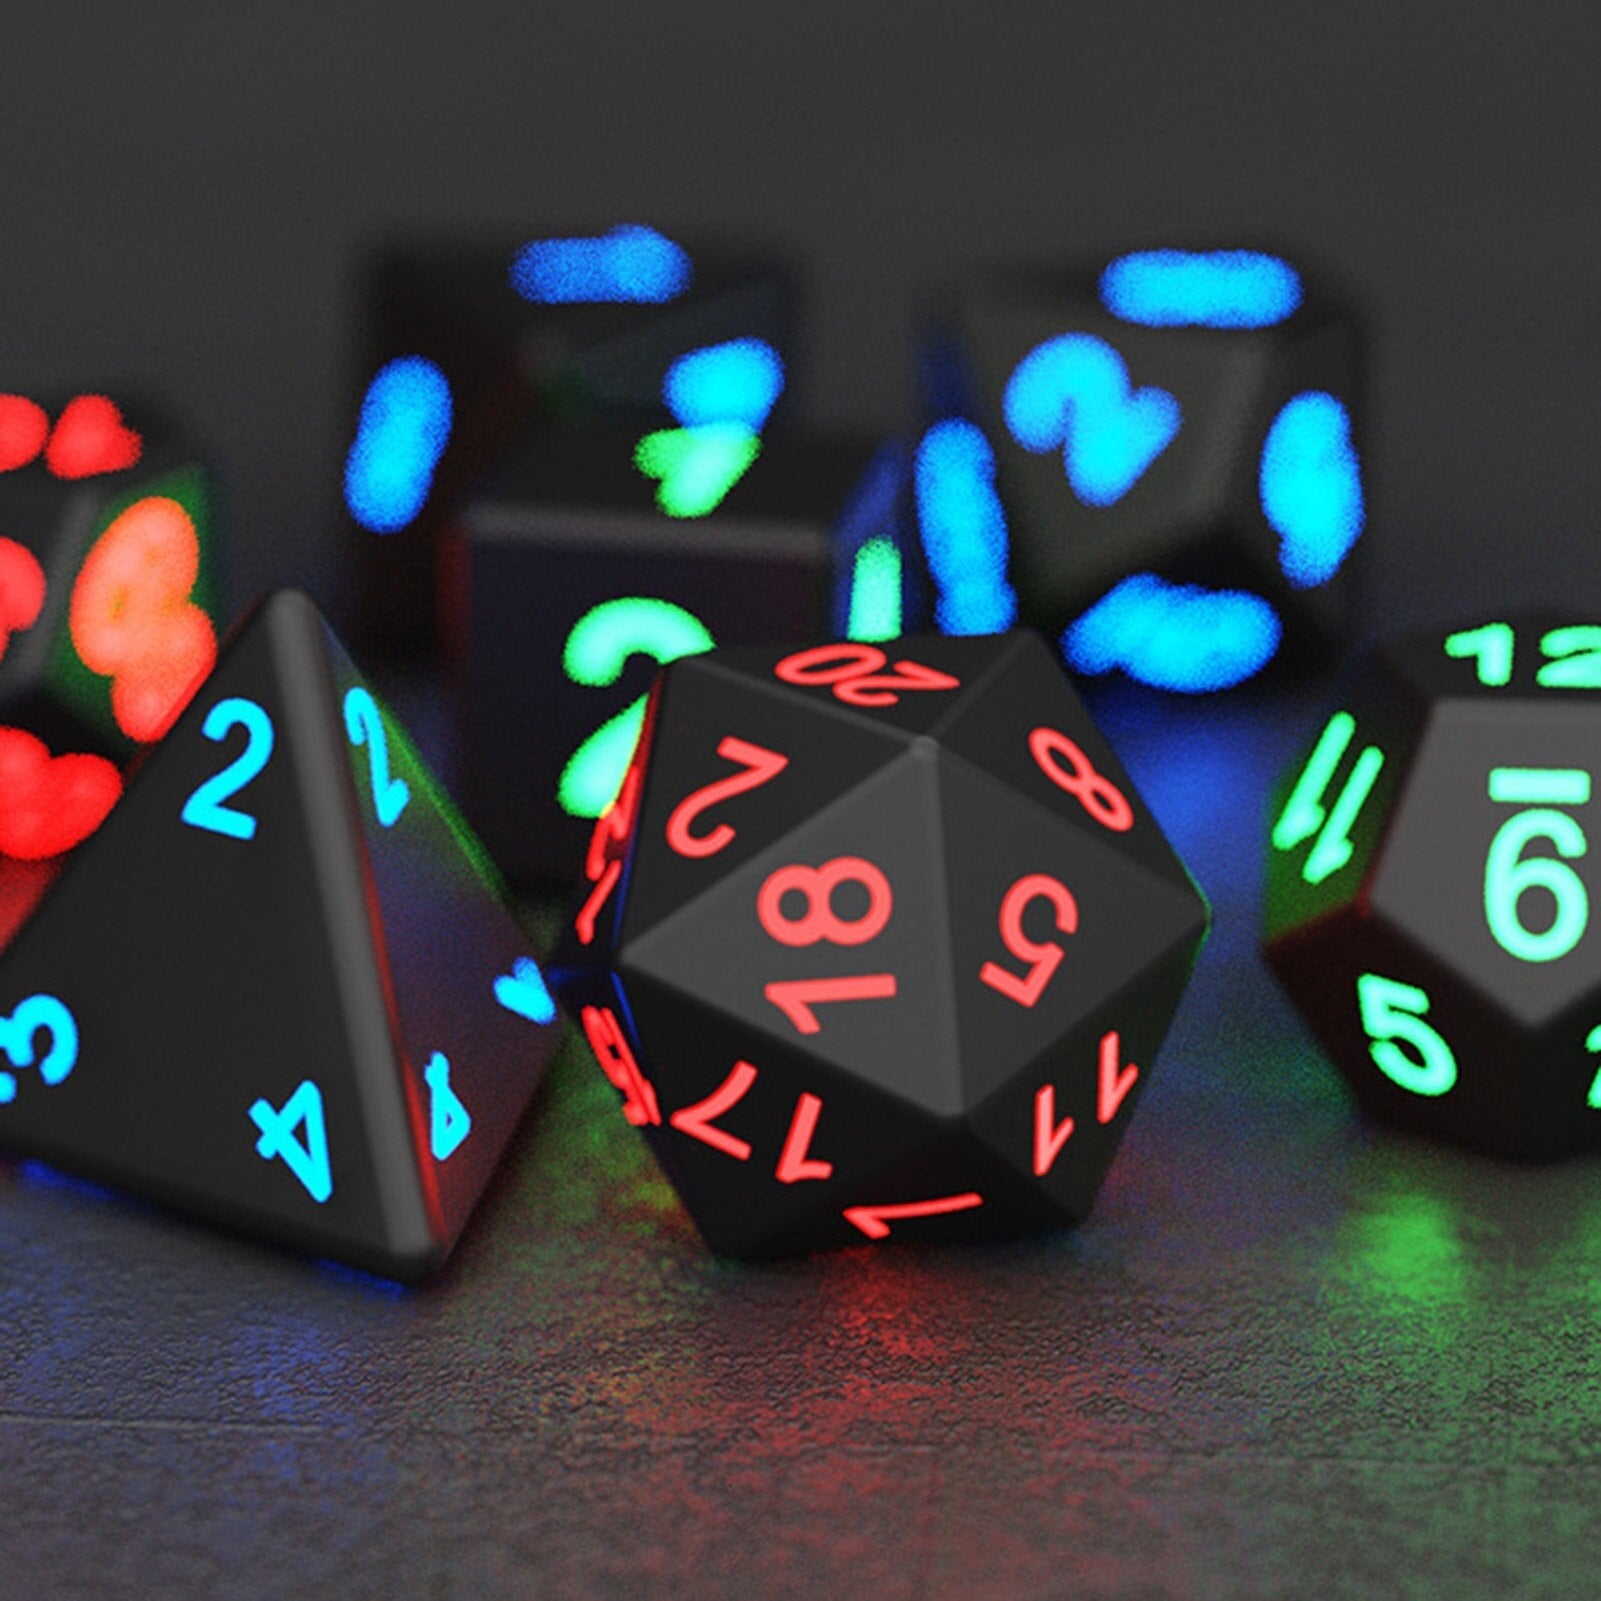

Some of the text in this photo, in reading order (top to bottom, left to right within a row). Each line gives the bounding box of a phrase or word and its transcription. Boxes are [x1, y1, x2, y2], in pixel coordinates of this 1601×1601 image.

[776, 644, 960, 706] 20
[182, 698, 273, 839] 2
[344, 687, 410, 827] 2
[666, 736, 788, 858] 2
[1029, 727, 1134, 832] 8
[756, 856, 897, 1035] 18
[980, 874, 1078, 1007] 5
[1357, 974, 1457, 1096] 5
[248, 1080, 332, 1203] 4
[670, 1061, 833, 1183] 17
